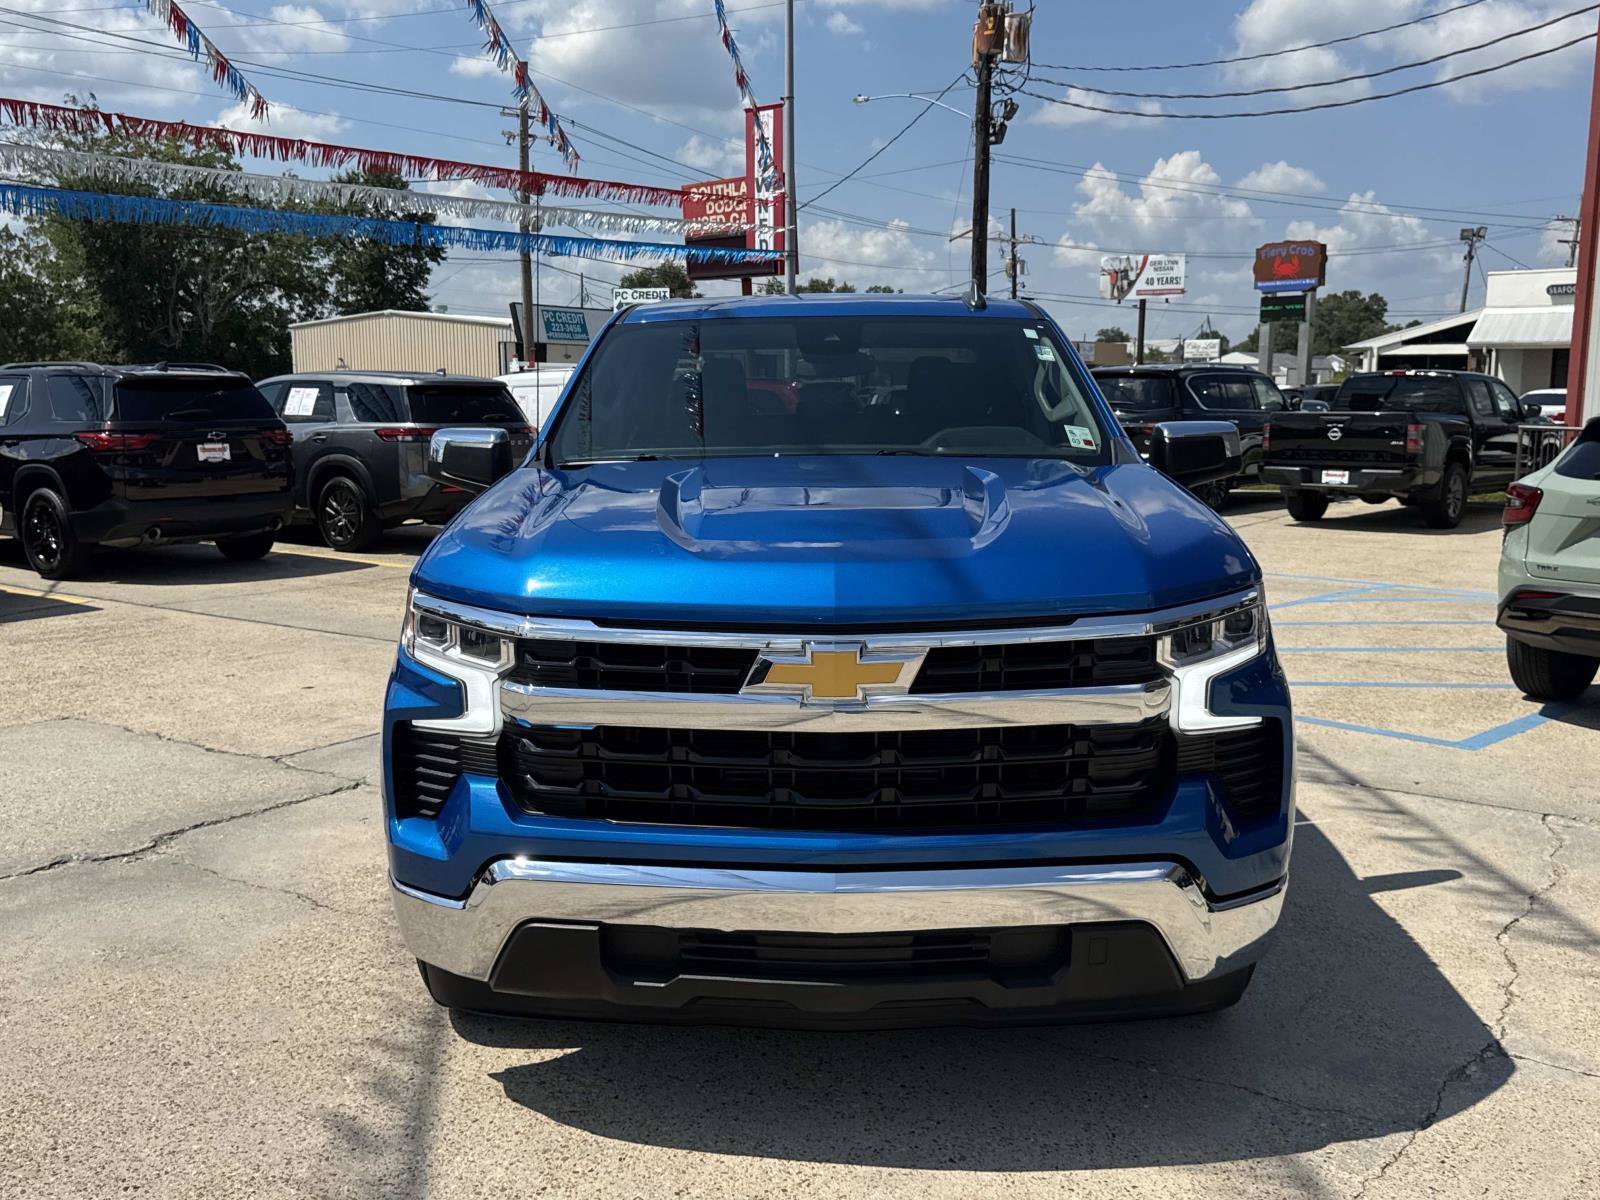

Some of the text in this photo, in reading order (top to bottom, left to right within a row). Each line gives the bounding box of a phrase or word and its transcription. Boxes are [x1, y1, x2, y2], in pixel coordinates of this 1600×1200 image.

[1145, 276, 1182, 286] 40 YEARS!
[615, 290, 668, 300] PC CREDIT
[543, 311, 585, 324] PC CREDIT
